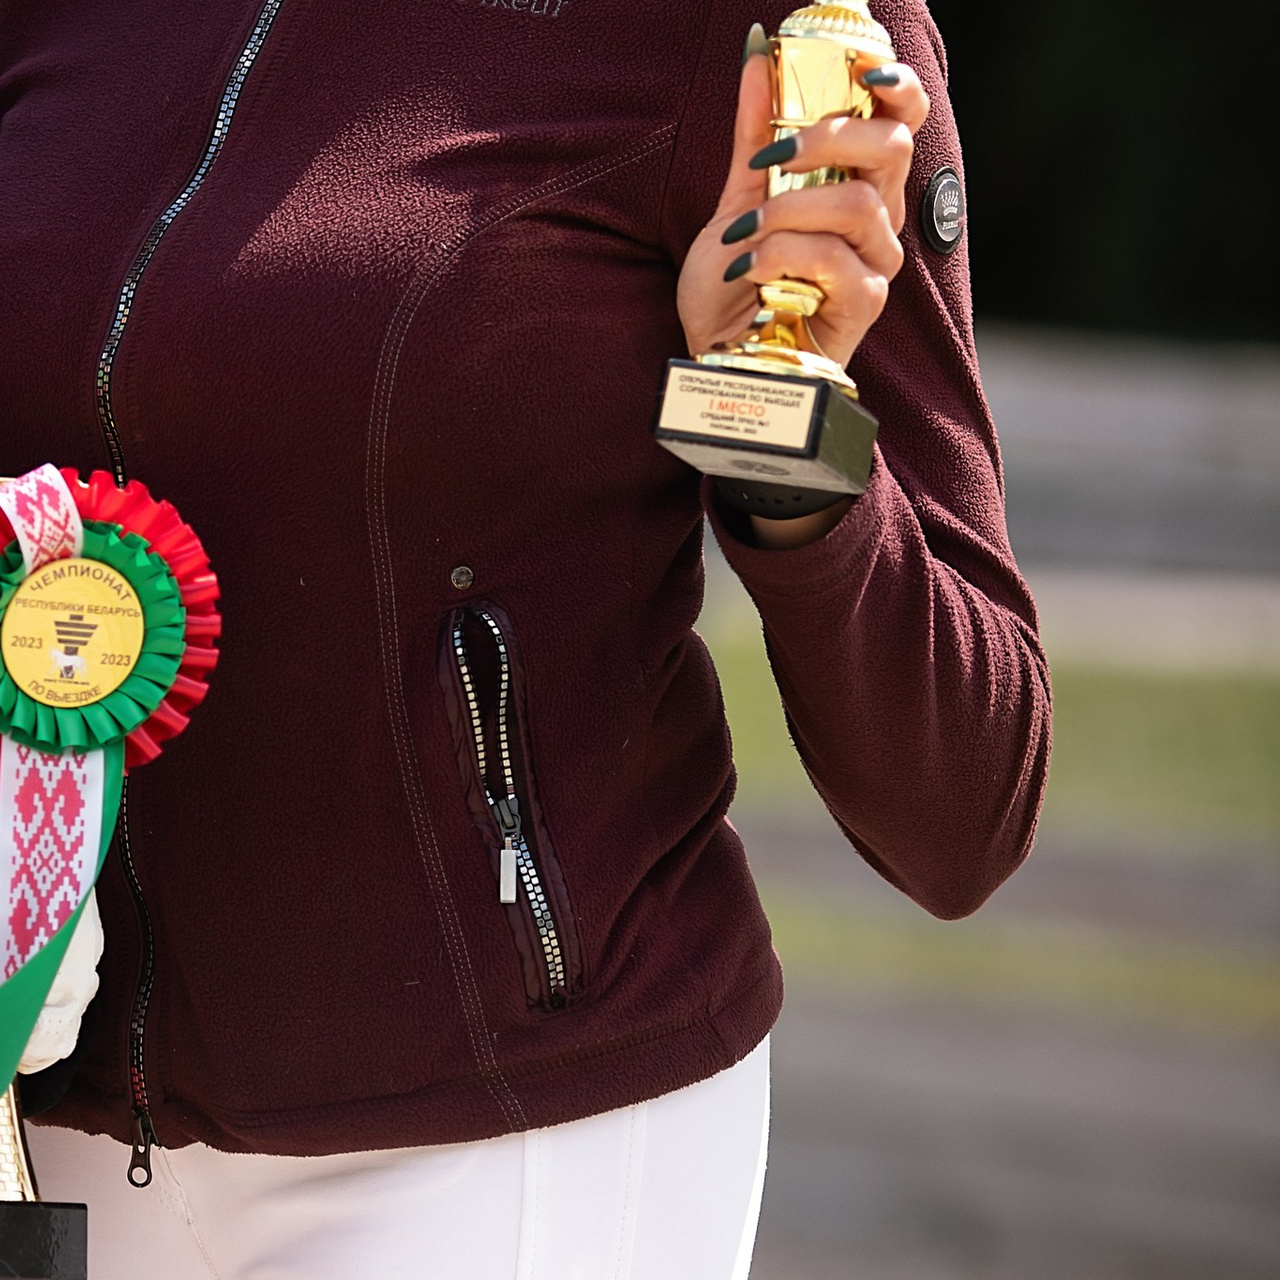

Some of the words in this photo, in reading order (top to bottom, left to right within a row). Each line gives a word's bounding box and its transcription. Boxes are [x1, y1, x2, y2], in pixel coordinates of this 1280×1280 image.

[717, 400, 766, 417] МЕСТО
[30, 565, 133, 601] ЧЕМПИОНАТ
[15, 598, 84, 613] РЕСПУБЛИКИ
[87, 604, 141, 618] БЕЛАРУСЬ
[11, 635, 43, 649] 2023
[101, 653, 132, 667] 2023
[28, 680, 45, 695] ПО
[45, 685, 102, 703] ВЫЕЗДКЕ
